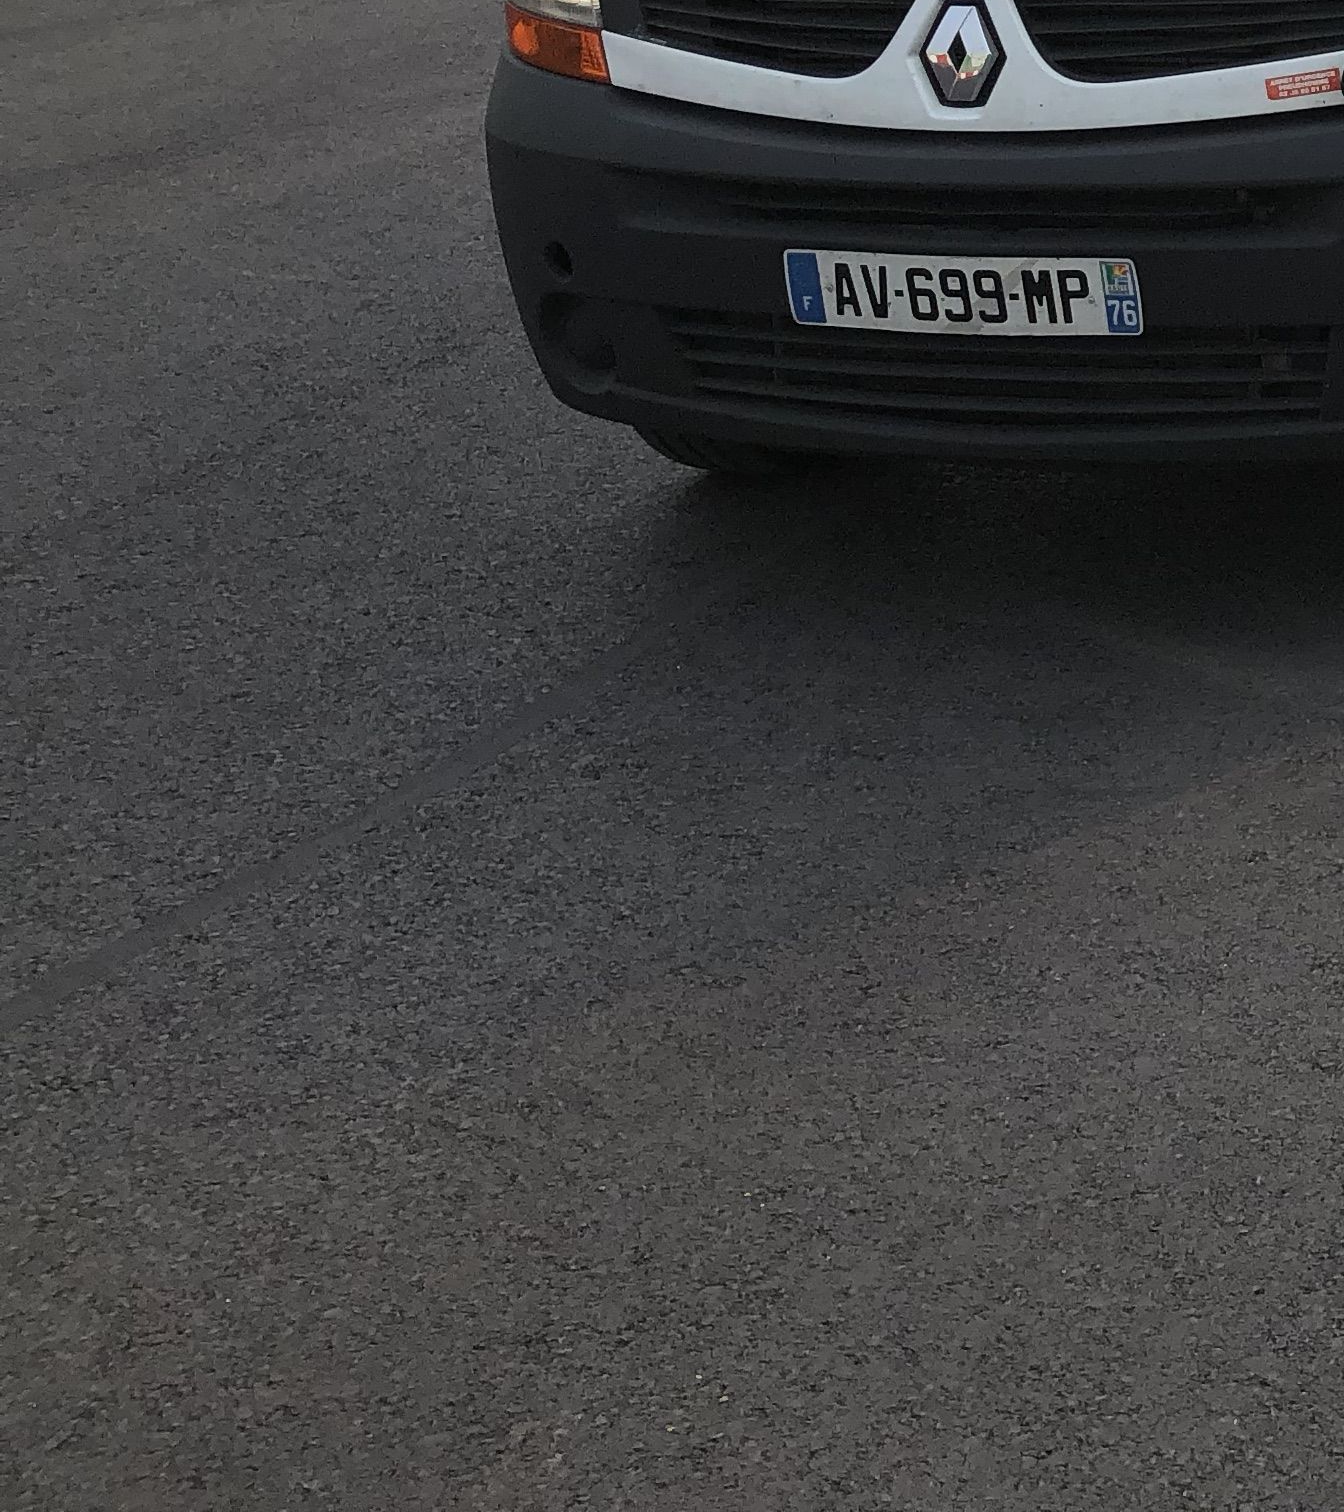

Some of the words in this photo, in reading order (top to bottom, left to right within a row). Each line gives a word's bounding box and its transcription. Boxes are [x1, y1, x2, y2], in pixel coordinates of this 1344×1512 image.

[802, 296, 812, 312] F
[834, 262, 1090, 325] AV-699-MP
[1107, 299, 1138, 326] 76
